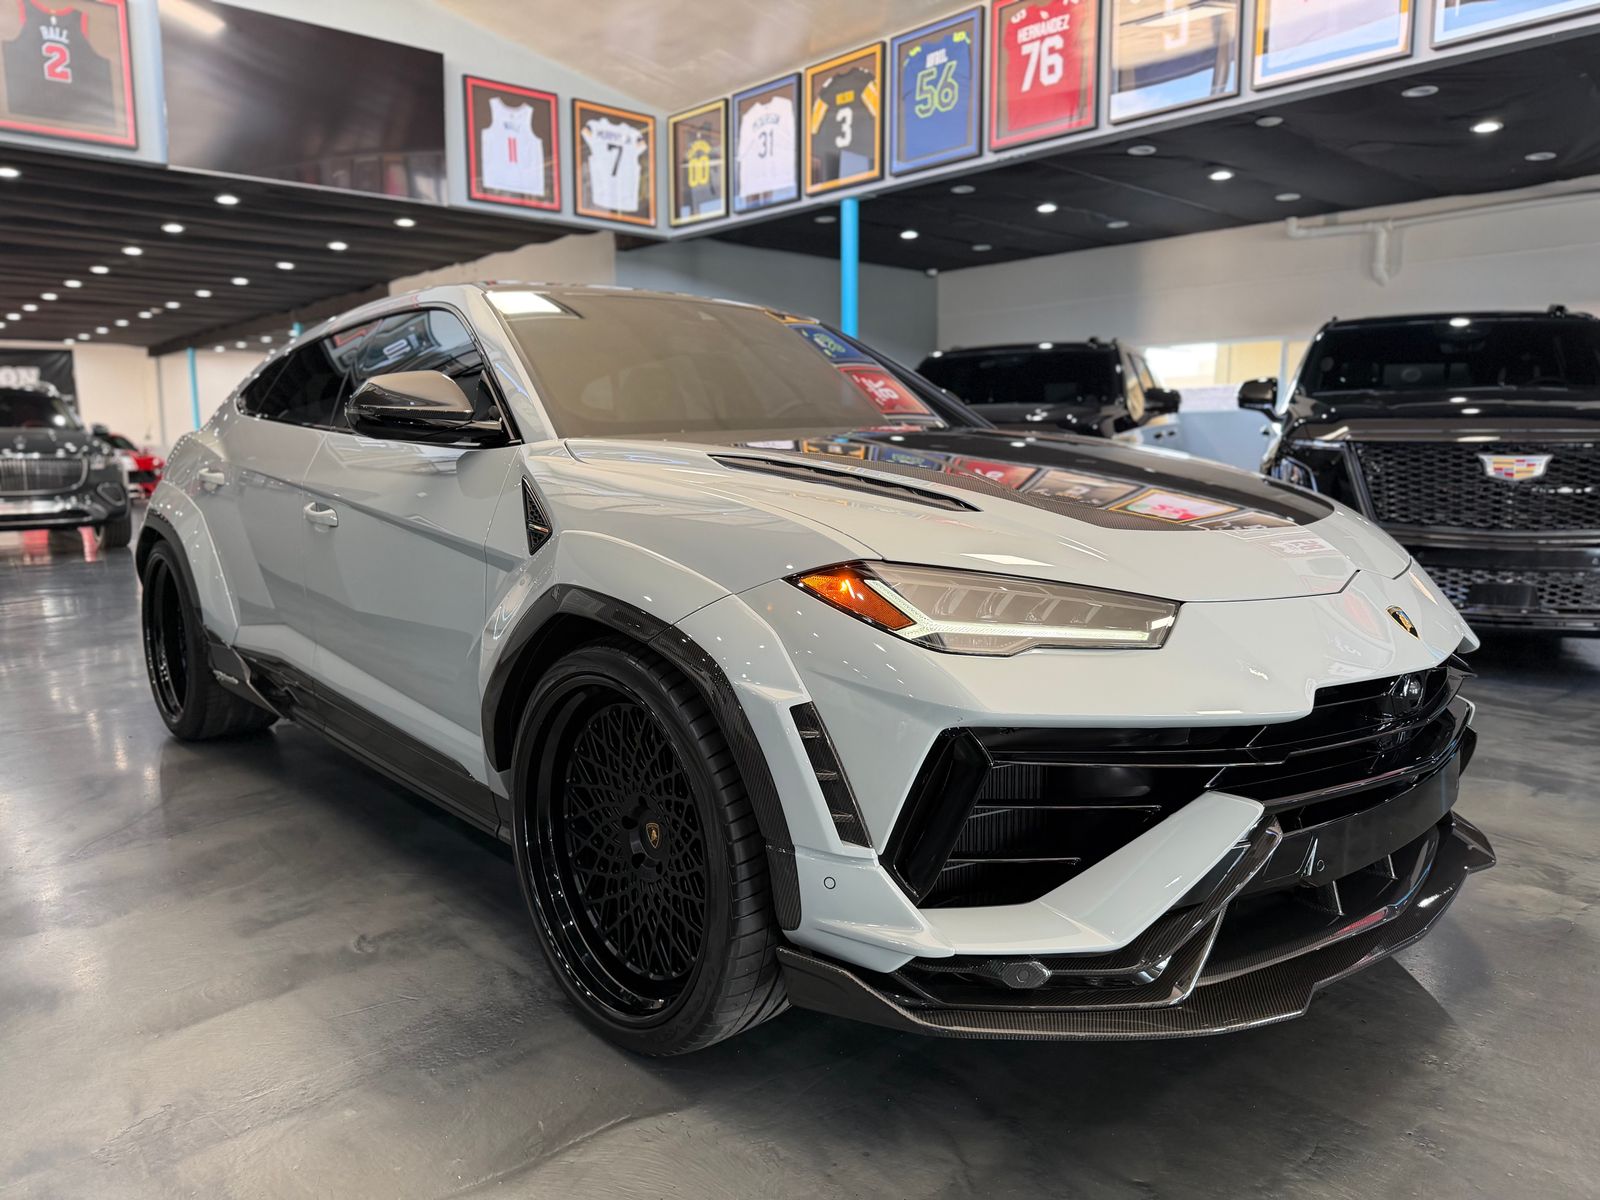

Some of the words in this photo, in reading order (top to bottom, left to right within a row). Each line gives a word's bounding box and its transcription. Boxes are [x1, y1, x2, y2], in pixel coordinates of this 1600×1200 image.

[42, 41, 72, 84] 2
[1020, 34, 1065, 94] 76
[914, 59, 959, 119] 56
[757, 128, 774, 160] 31
[835, 106, 853, 148] 3
[507, 135, 519, 164] 11
[607, 143, 623, 177] 7
